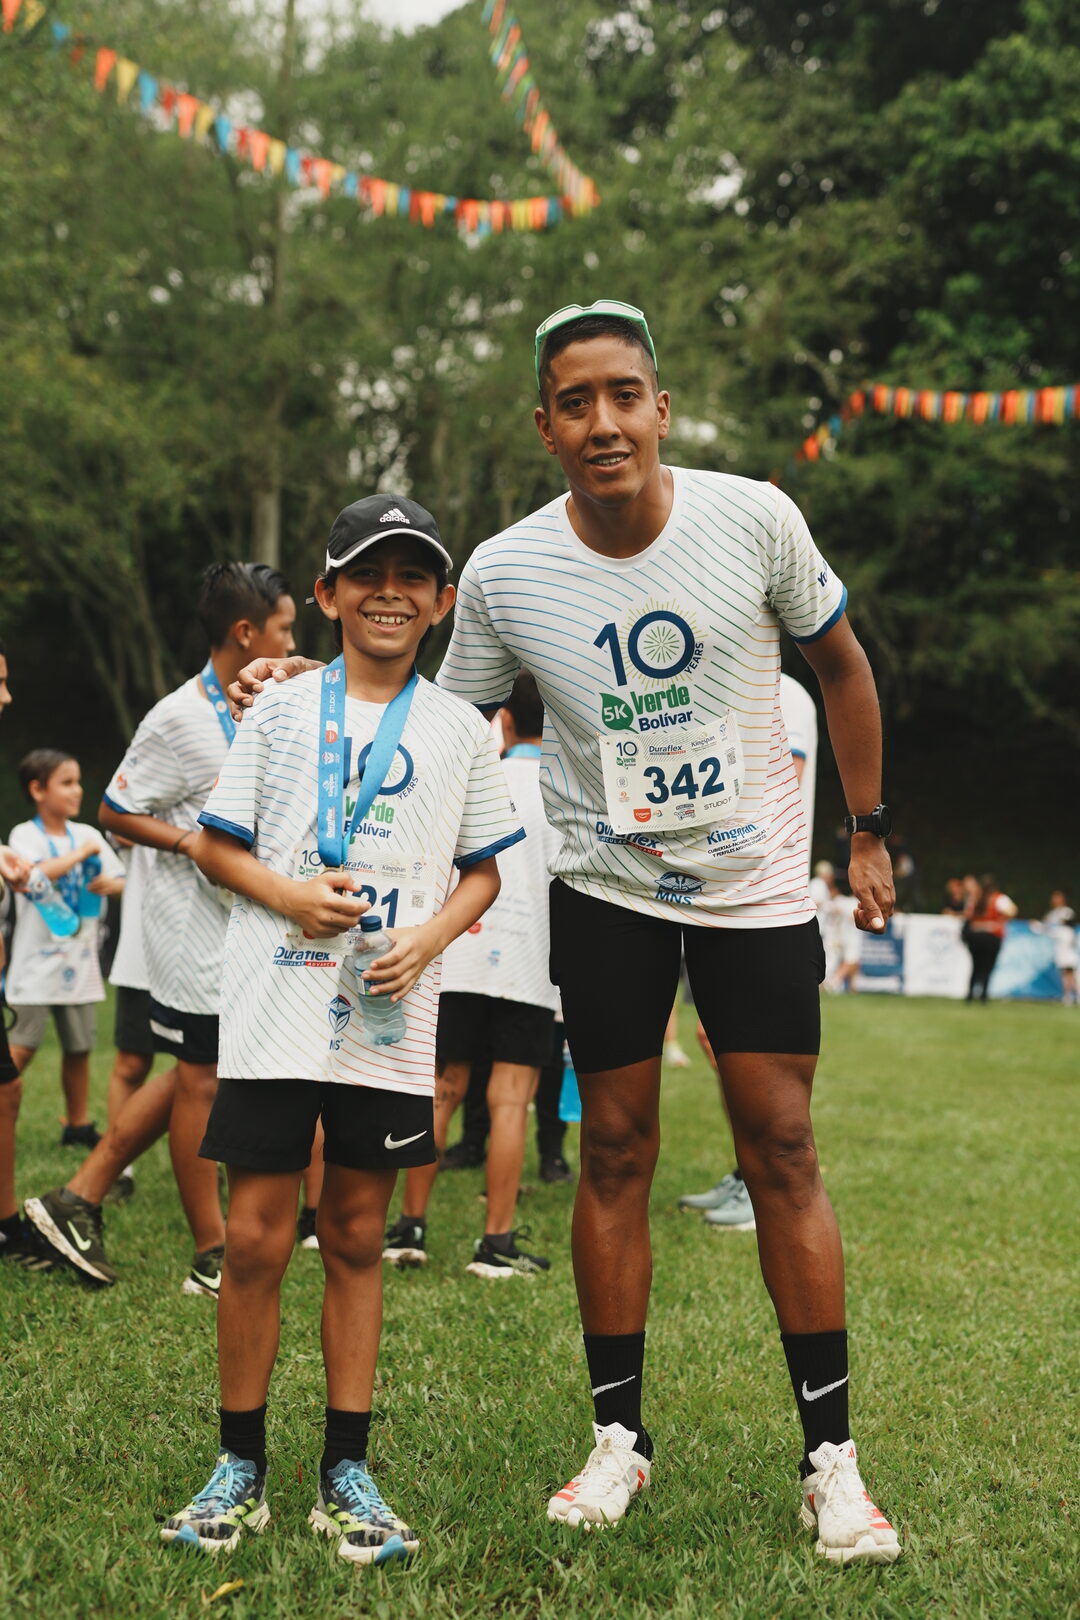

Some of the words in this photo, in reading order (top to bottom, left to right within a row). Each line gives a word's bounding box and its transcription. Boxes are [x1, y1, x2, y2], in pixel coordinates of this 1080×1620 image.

[379, 515, 411, 525] adidas
[593, 610, 695, 687] 10
[684, 641, 704, 675] YEARS
[603, 704, 628, 722] 5K
[638, 710, 693, 731] Bolívar
[616, 741, 638, 757] 10
[649, 745, 683, 753] Duraflex
[397, 776, 419, 800] YEARS
[643, 756, 725, 805] 342
[345, 795, 395, 824] Vrde
[704, 798, 729, 811] STUDIO
[595, 821, 657, 849] Duflex
[302, 850, 322, 866] 10
[345, 860, 374, 870] raflex
[655, 890, 692, 905] MNS
[273, 946, 330, 961] Duraflex
